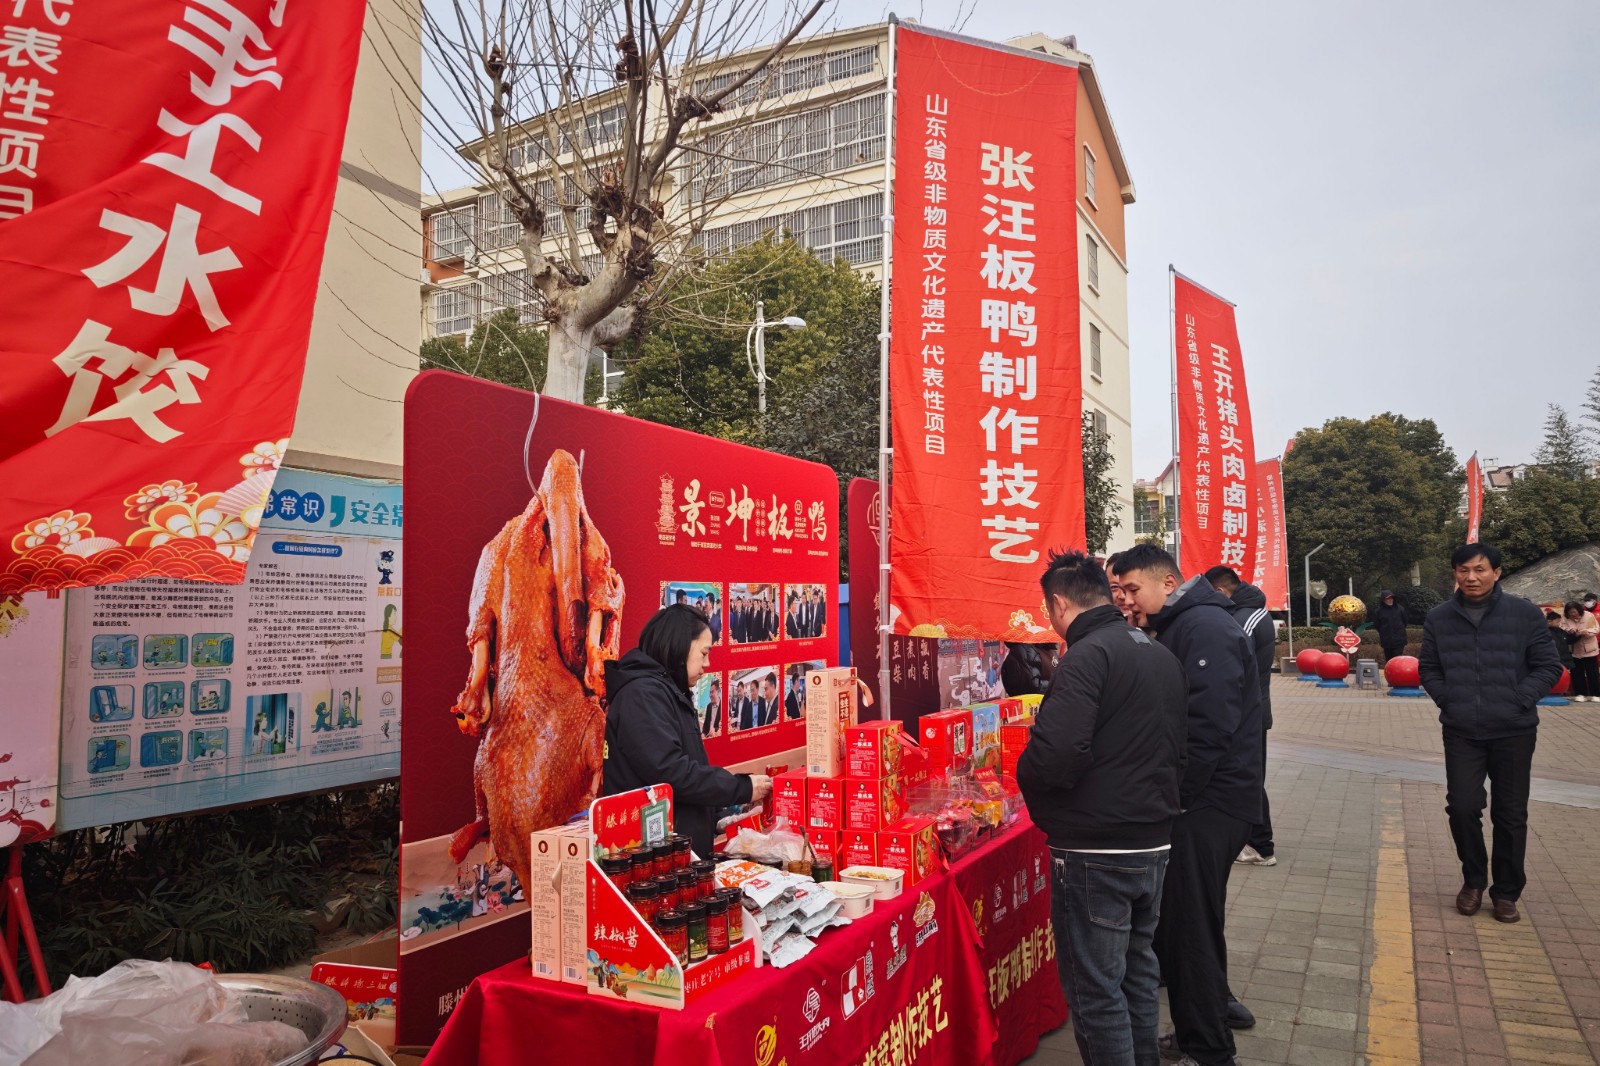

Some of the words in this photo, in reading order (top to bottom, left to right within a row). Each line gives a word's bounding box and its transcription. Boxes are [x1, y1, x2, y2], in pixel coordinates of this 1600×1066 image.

[44, 0, 287, 443] 手工水饺
[921, 93, 948, 456] 山东省级非物质文化遗产代表性项目
[979, 142, 1041, 565] 张汪板鸭制作技艺
[1185, 313, 1211, 529] 山东省级非物质文化遗产代表性项目
[1210, 342, 1248, 578] 王开猪头肉卤制技
[593, 922, 639, 949] 辣椒酱
